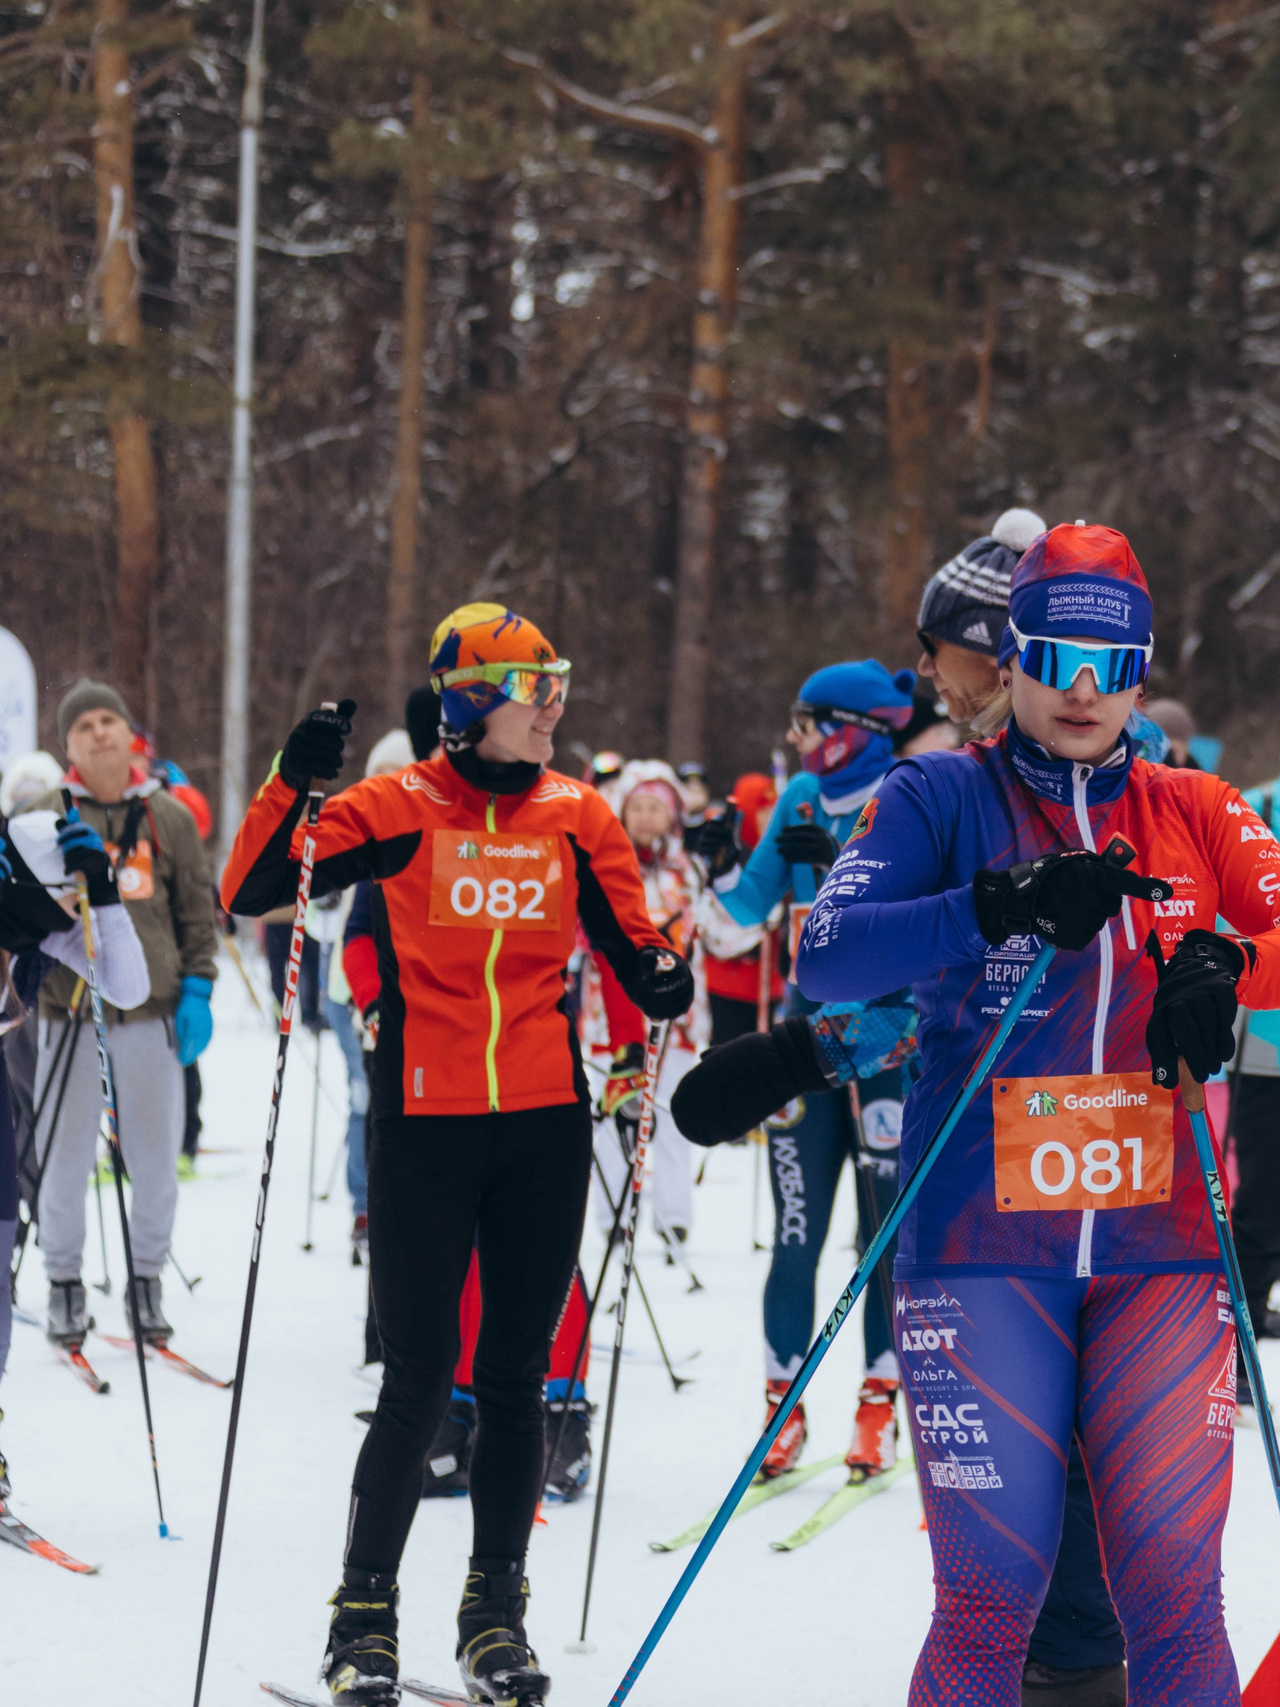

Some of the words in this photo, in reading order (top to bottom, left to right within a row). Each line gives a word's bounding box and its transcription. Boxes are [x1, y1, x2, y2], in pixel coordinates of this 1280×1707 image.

[1047, 605, 1082, 614] АЛЕКСАНДРА
[1048, 594, 1095, 607] ЛЫЖНЫЙ
[1097, 597, 1122, 610] КЛУБ
[484, 844, 539, 859] Goodline
[119, 870, 141, 892] 9
[450, 876, 545, 919] 082
[1154, 900, 1196, 917] АЗОТ
[1063, 1089, 1148, 1110] Goodline
[1030, 1137, 1143, 1196] 081
[906, 1293, 962, 1309] НОРЭЙЛ
[902, 1328, 958, 1351] АЗОТ
[913, 1370, 958, 1382] ОЛЬГА
[915, 1403, 984, 1430] СДС
[920, 1427, 989, 1444] СТРОЙ
